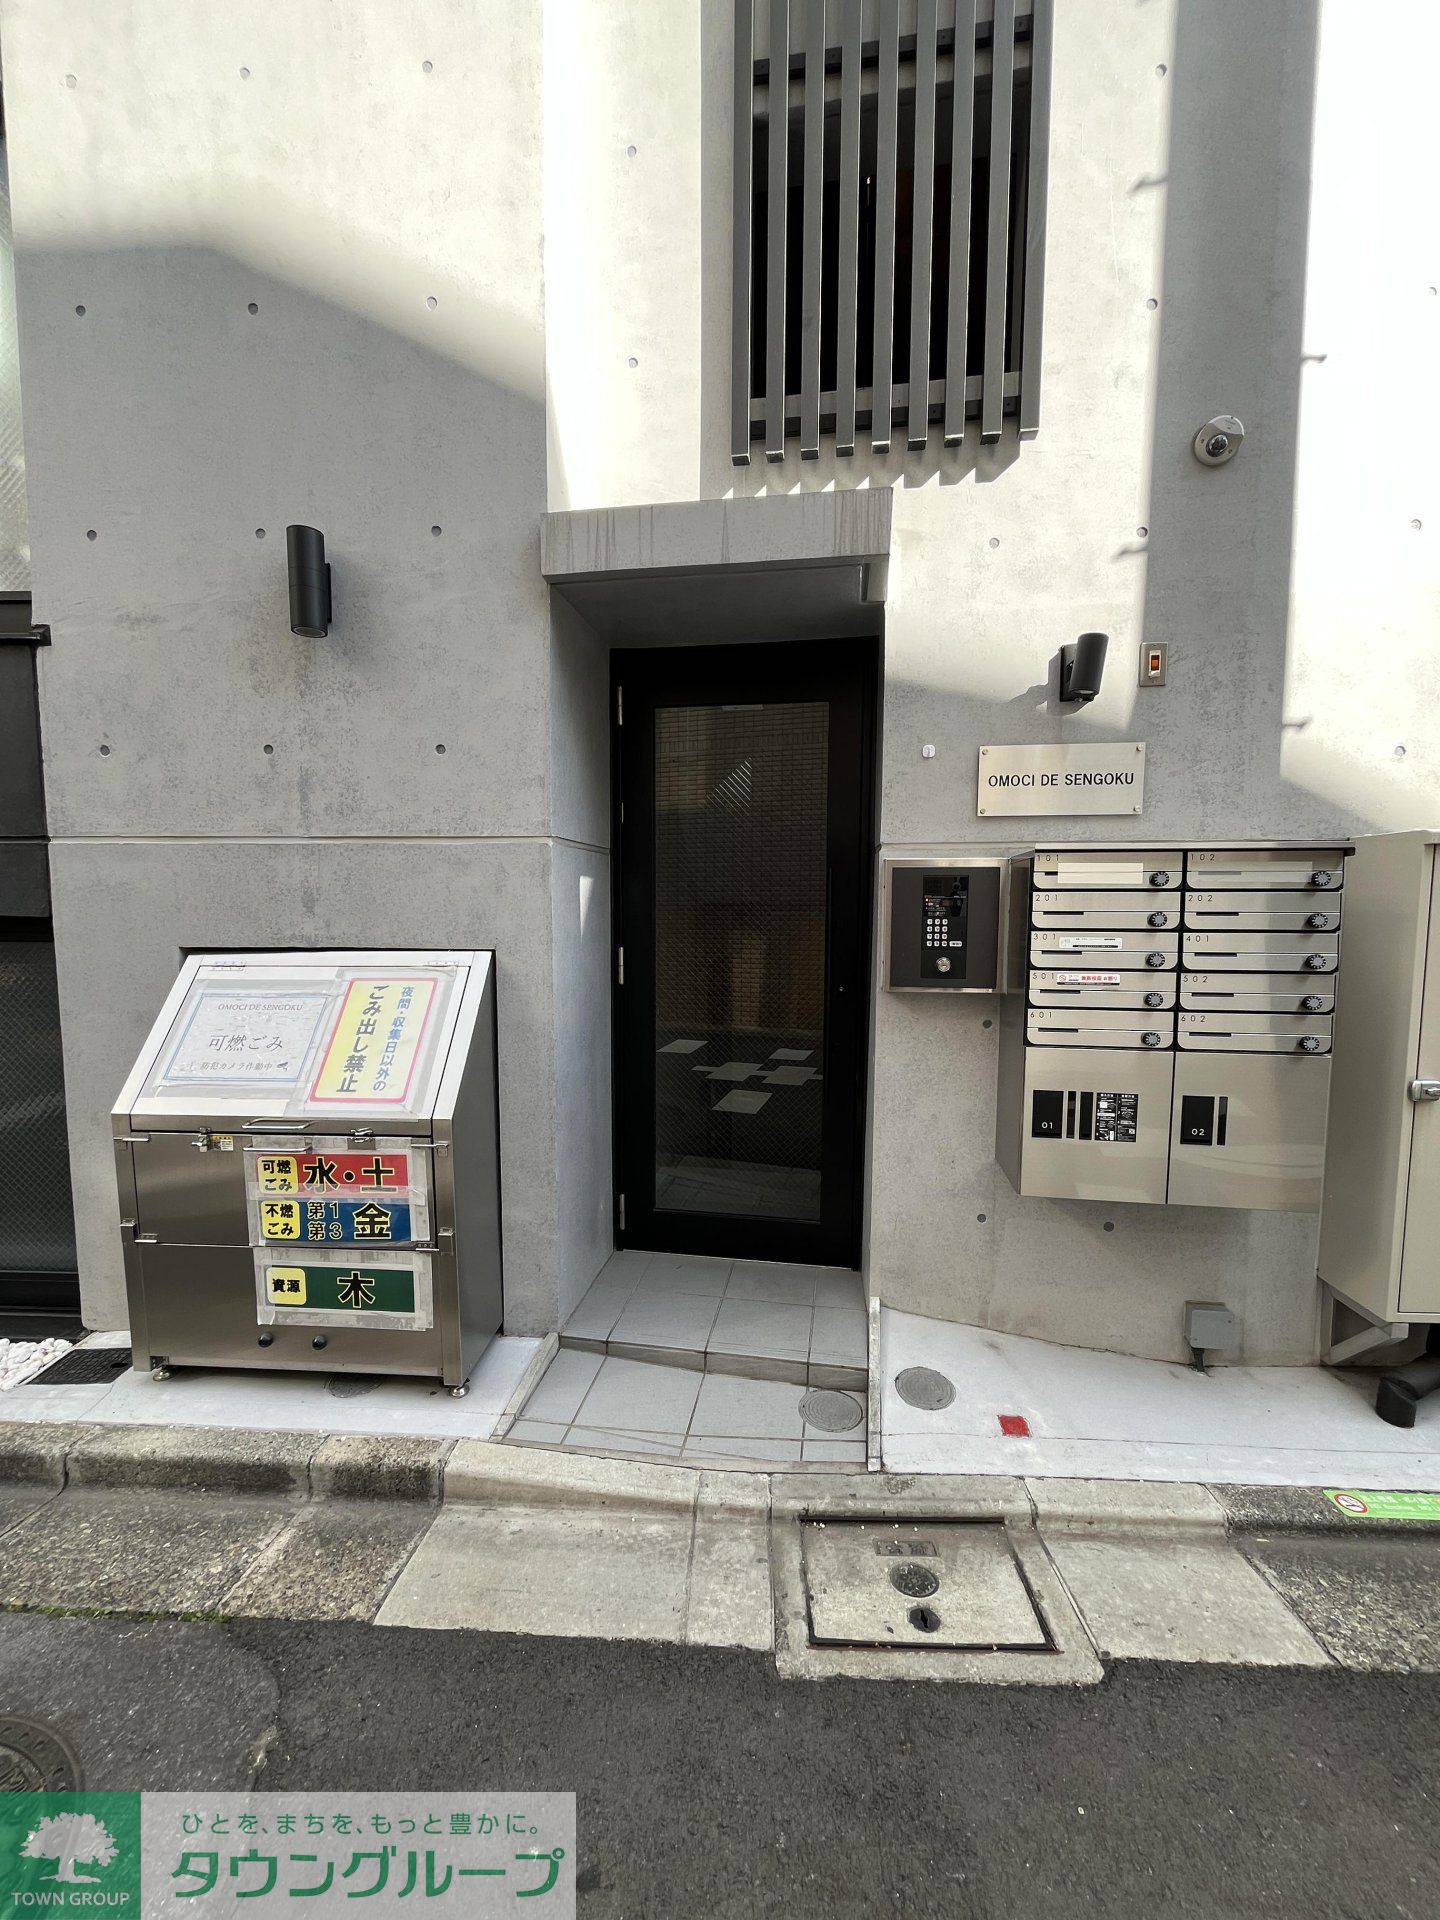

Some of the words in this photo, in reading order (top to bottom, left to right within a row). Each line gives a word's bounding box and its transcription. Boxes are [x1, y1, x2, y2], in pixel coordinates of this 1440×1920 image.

[988, 774, 1035, 787] OMOCI
[1040, 773, 1059, 787] DE
[1064, 772, 1135, 786] SENGOKU
[1036, 854, 1059, 862] 101
[1191, 853, 1215, 861] 102
[1035, 894, 1058, 902] 201
[1188, 894, 1213, 902] 202
[1183, 975, 1208, 983] 502
[218, 1003, 247, 1011] OMOCI
[249, 1003, 261, 1011] DE
[262, 1003, 304, 1011] SENGOKU
[208, 1034, 283, 1052] 可燃ごみ
[336, 985, 389, 1092] ごみ出し禁止
[373, 986, 414, 1091] 夜間・収集日以外の
[200, 1062, 273, 1071] 防犯カメラ作動中
[1041, 1121, 1053, 1129] 01
[1191, 1128, 1205, 1136] 02
[261, 1159, 292, 1174] 可燃
[303, 1156, 399, 1194] 水・土
[264, 1178, 293, 1192] ごみ
[265, 1203, 294, 1218] 不燃
[307, 1201, 339, 1219] 第1
[352, 1201, 391, 1240] 金
[267, 1222, 294, 1236] ごみ
[308, 1221, 342, 1241] 第3
[272, 1278, 301, 1293] 資源
[336, 1270, 376, 1308] 木
